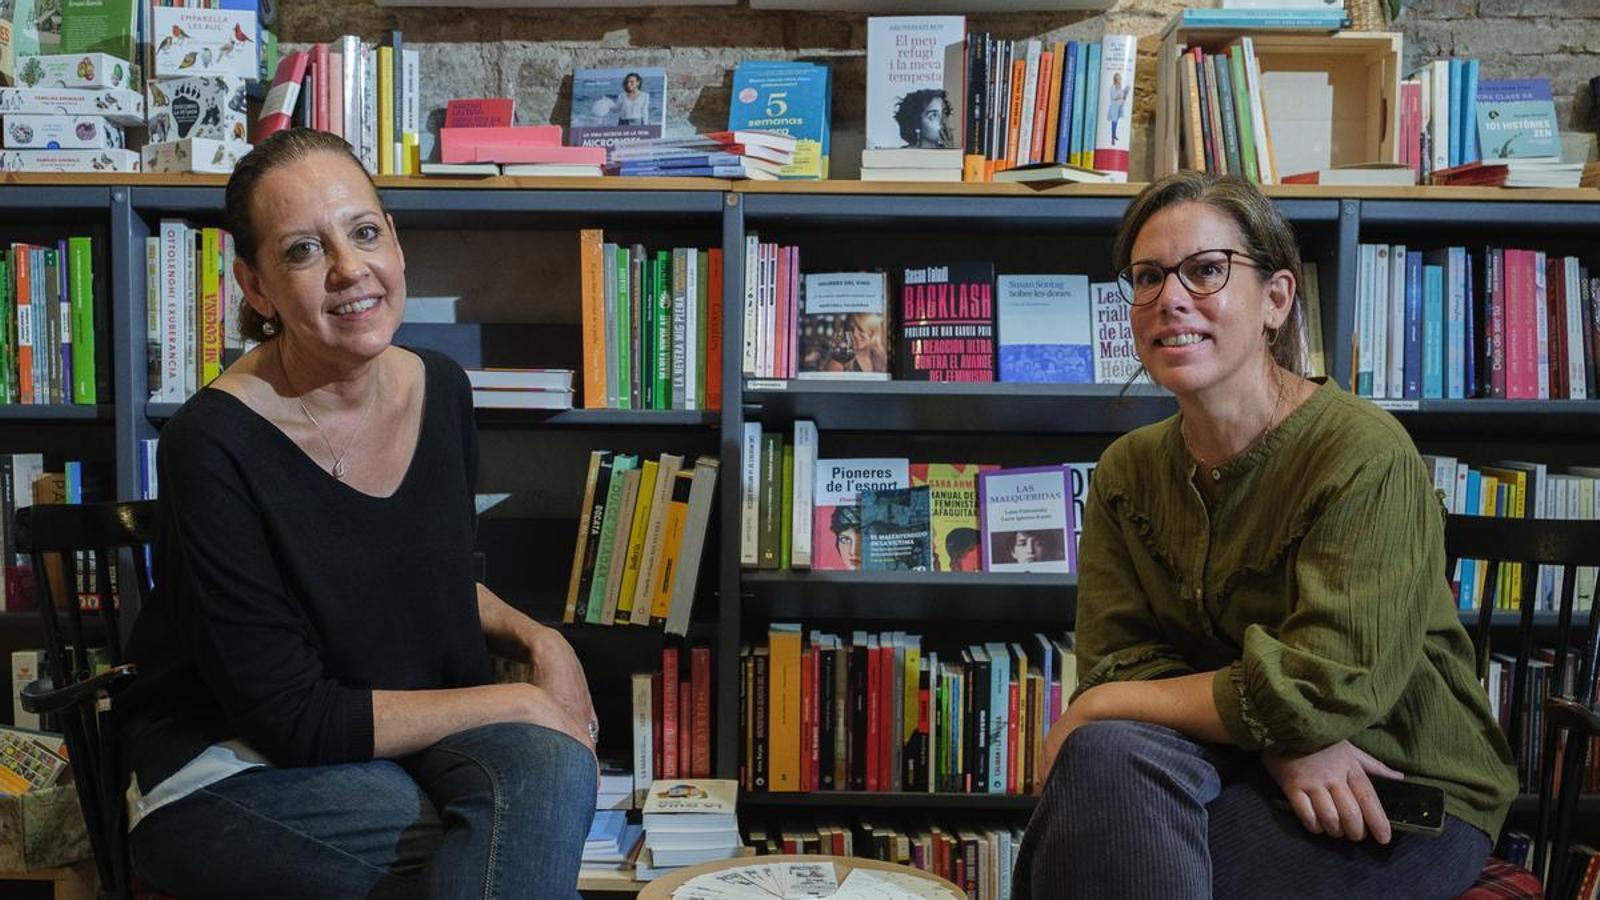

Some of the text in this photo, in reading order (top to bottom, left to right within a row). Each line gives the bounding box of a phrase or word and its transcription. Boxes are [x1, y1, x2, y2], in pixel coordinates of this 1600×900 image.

[896, 34, 936, 46] El meu
[898, 47, 933, 60] refugi
[896, 59, 907, 70] la
[910, 61, 941, 70] meva
[889, 71, 941, 84] tempesta
[765, 92, 788, 117] 5
[748, 117, 803, 127] semanas
[1486, 122, 1500, 130] 101
[1534, 129, 1552, 137] ZEN
[1008, 280, 1065, 290] Susan Sontag
[1008, 289, 1033, 297] Sobre
[1097, 288, 1123, 304] Les
[168, 229, 176, 379] OTTOLENGHI EXUBERANCIA
[904, 283, 992, 320] BACKLASH
[1098, 304, 1129, 322] riall
[204, 294, 219, 363] MI COCINA
[1099, 323, 1132, 340] de la
[1493, 318, 1503, 332] ser
[674, 296, 685, 388] LA NEVERA MIG PLENA
[1492, 334, 1503, 345] de
[912, 339, 922, 354] LA
[915, 354, 948, 370] CONTRA
[949, 354, 958, 369] EL
[1492, 347, 1503, 371] Deja
[832, 466, 892, 479] Pioneres
[826, 479, 897, 492] de l'esport
[1016, 484, 1034, 493] LAS
[935, 500, 975, 508] FEMINIST
[990, 492, 1061, 503] MALQUERIDAS
